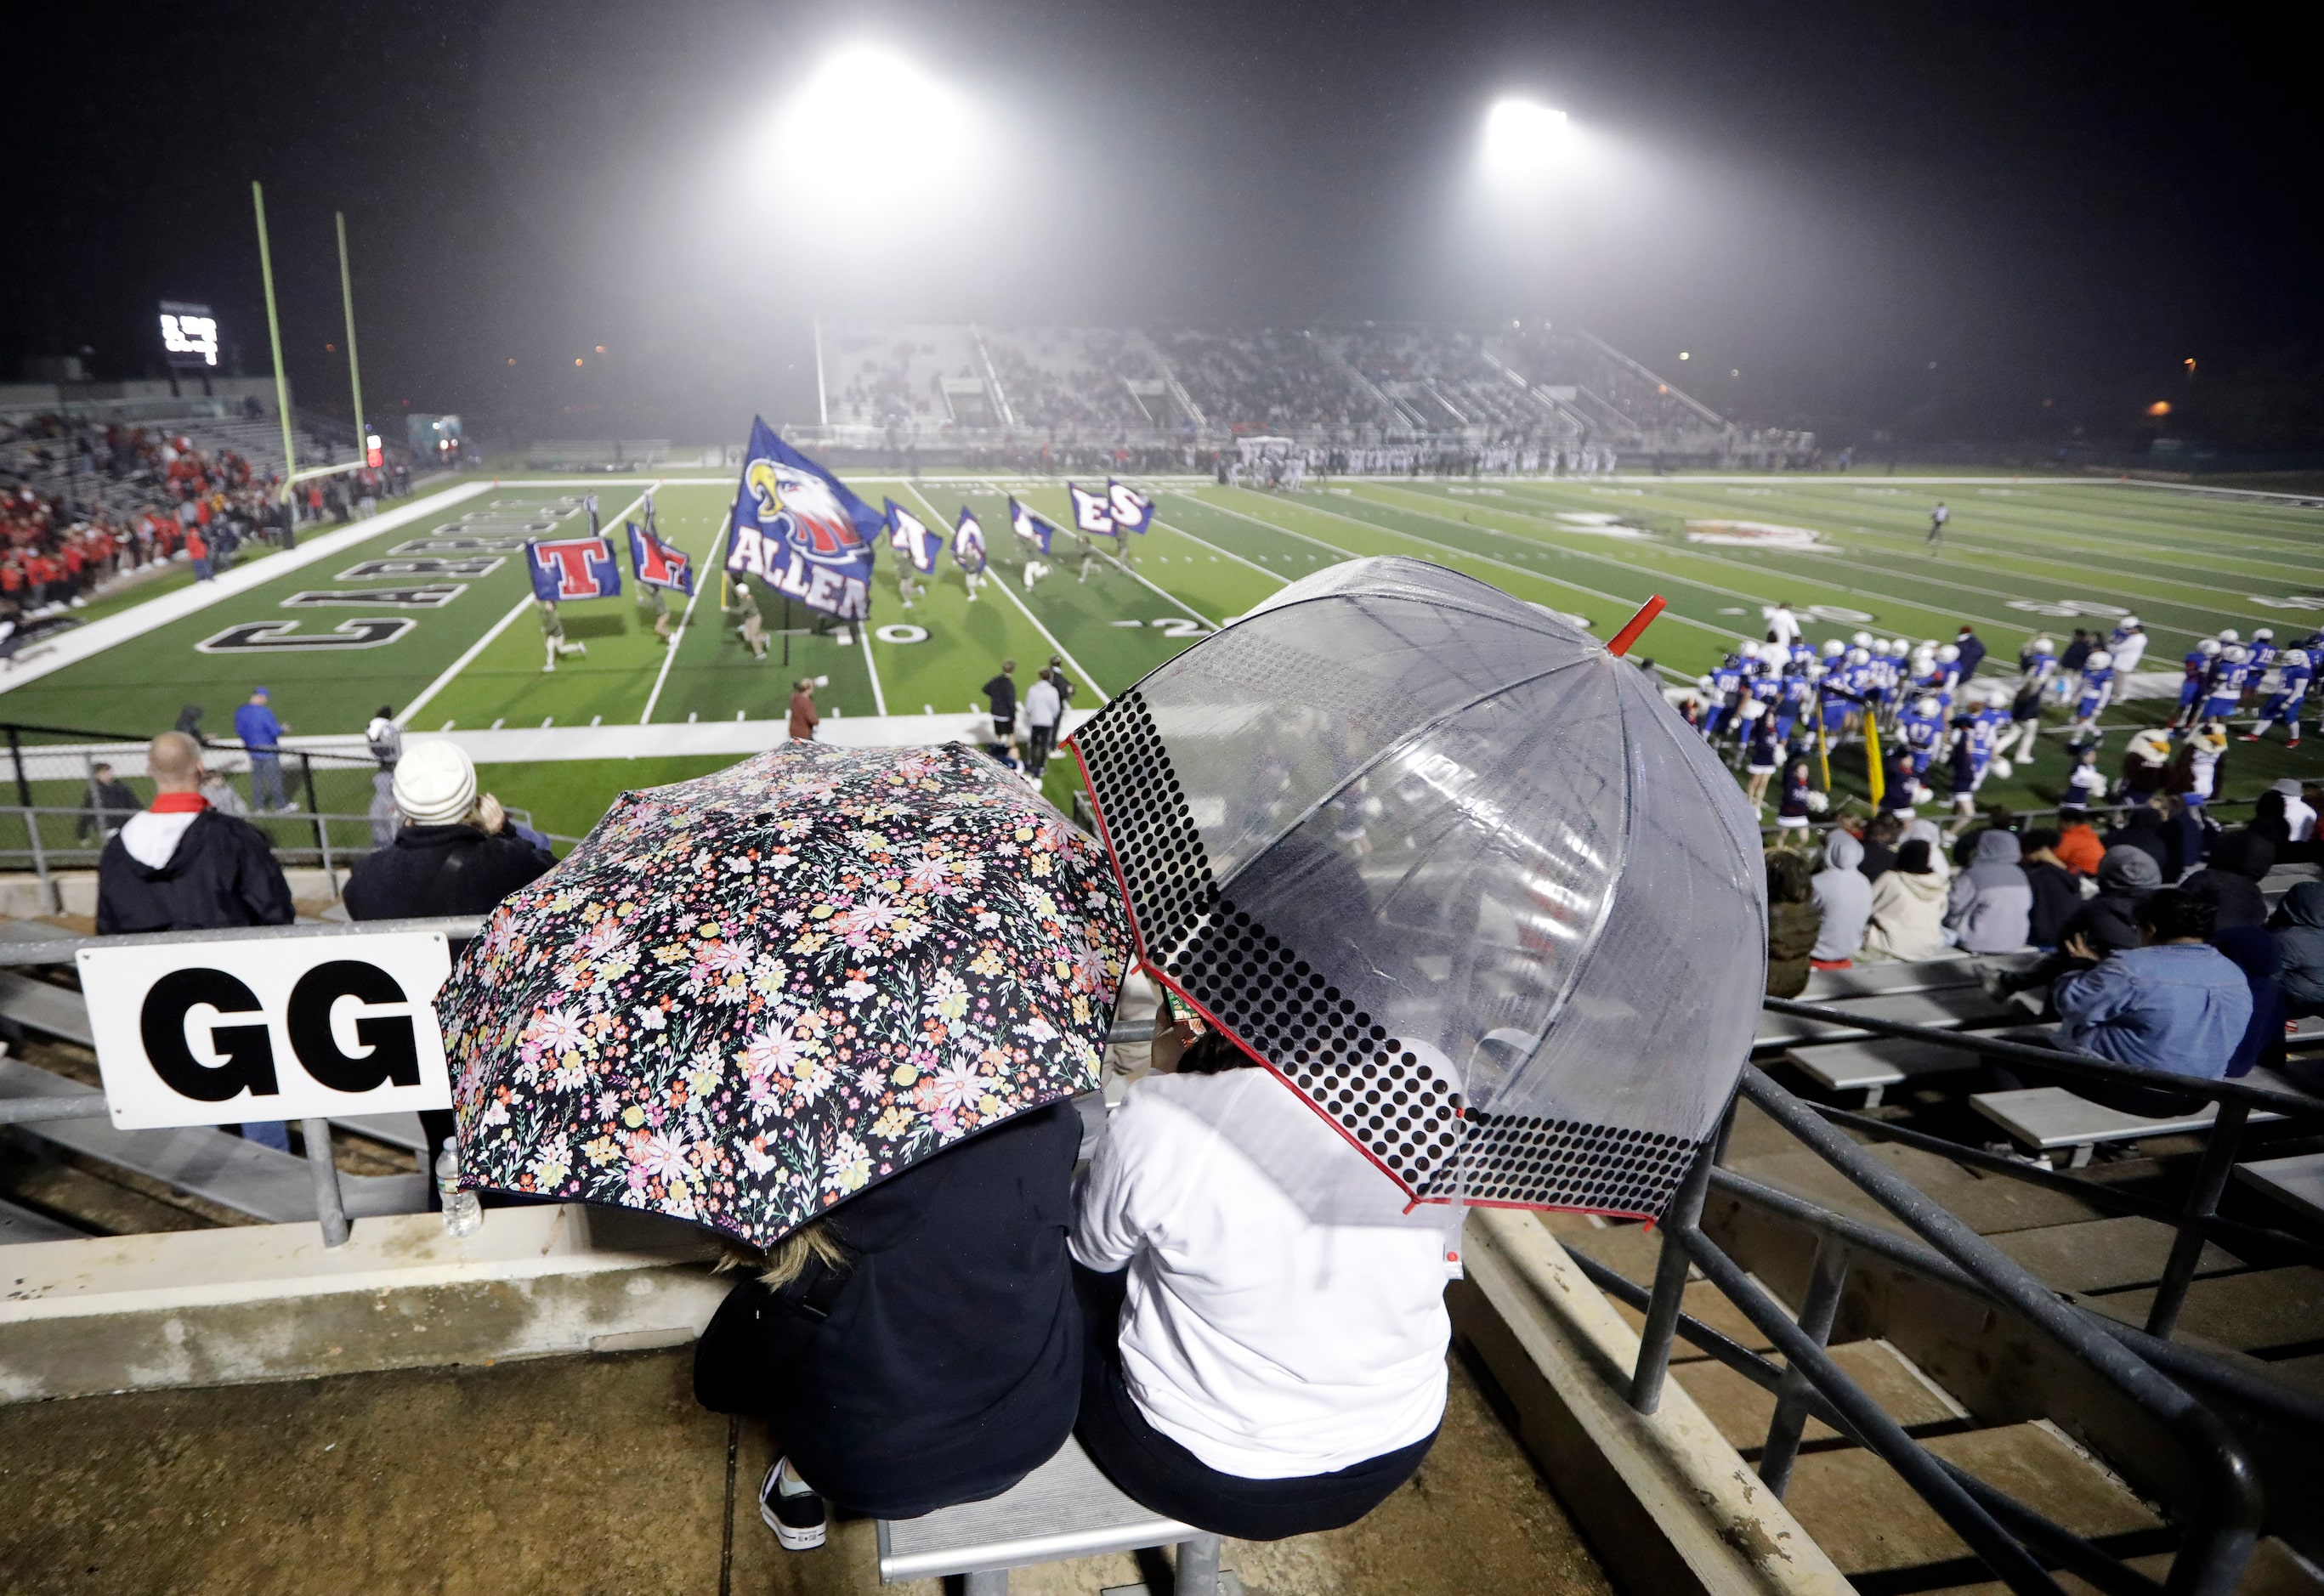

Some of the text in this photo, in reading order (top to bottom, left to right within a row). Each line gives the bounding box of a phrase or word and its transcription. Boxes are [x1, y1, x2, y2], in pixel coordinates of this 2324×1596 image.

[1071, 488, 1113, 534] E
[1109, 484, 1151, 526] S
[534, 539, 609, 600] T
[728, 526, 868, 620] ALLEN
[140, 959, 422, 1102] GG
